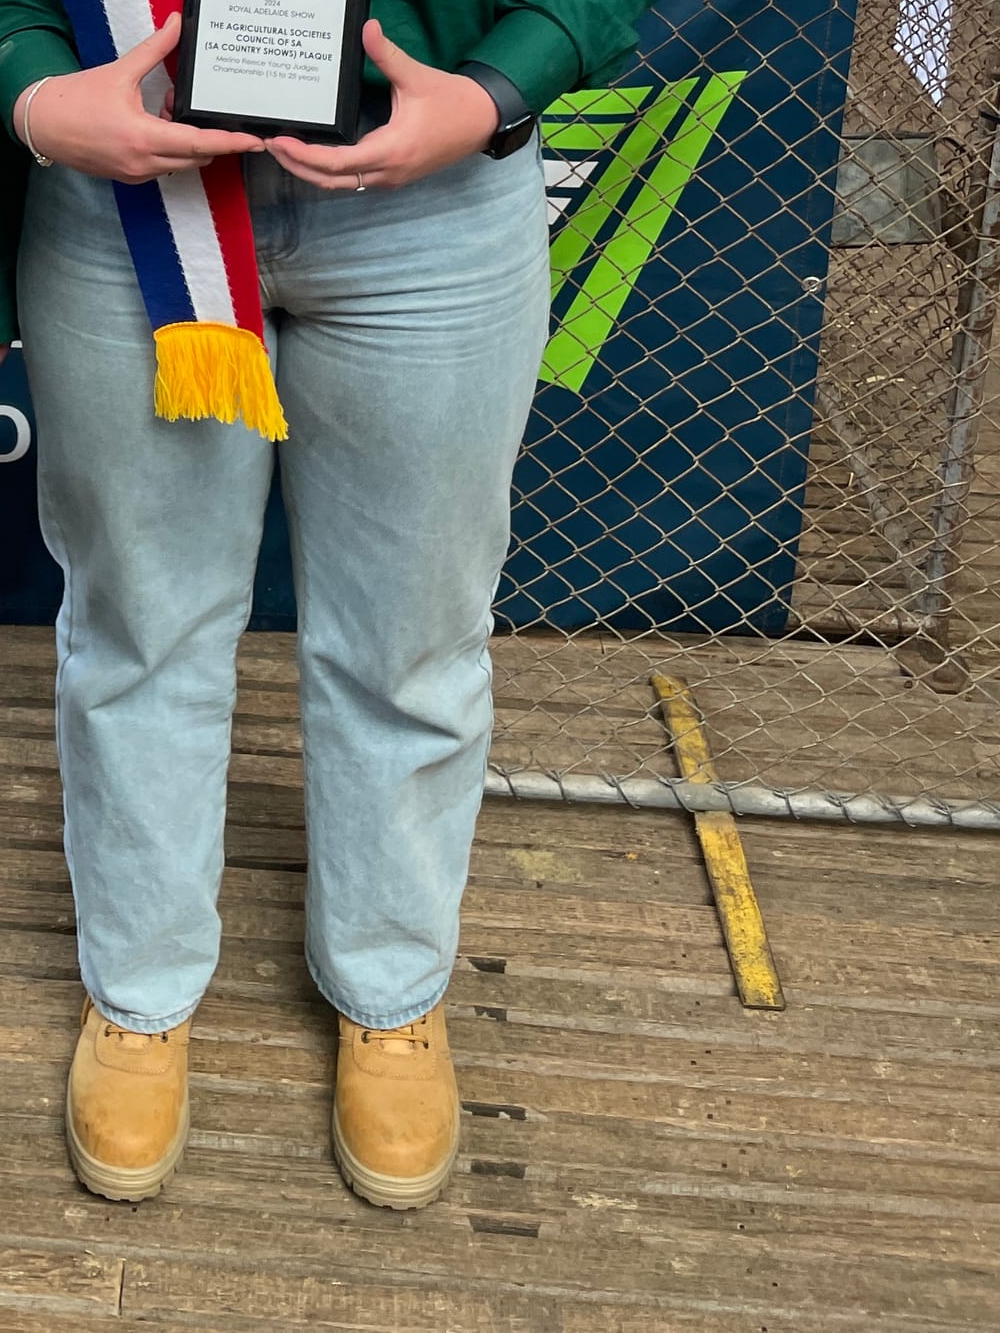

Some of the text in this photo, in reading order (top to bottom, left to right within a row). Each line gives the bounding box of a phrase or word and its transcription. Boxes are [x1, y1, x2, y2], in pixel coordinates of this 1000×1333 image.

[264, 0, 281, 7] 2024
[228, 5, 315, 19] ROYAL ADELAIDE SHOW
[210, 21, 331, 40] THE AGRICULTURAL SOCIETIES
[236, 34, 302, 47] COUNCIL OF SA
[204, 41, 333, 61] (SA COUNTRY SHOWS) PLAQUE
[212, 65, 320, 83] Championship (15 to 25 years)
